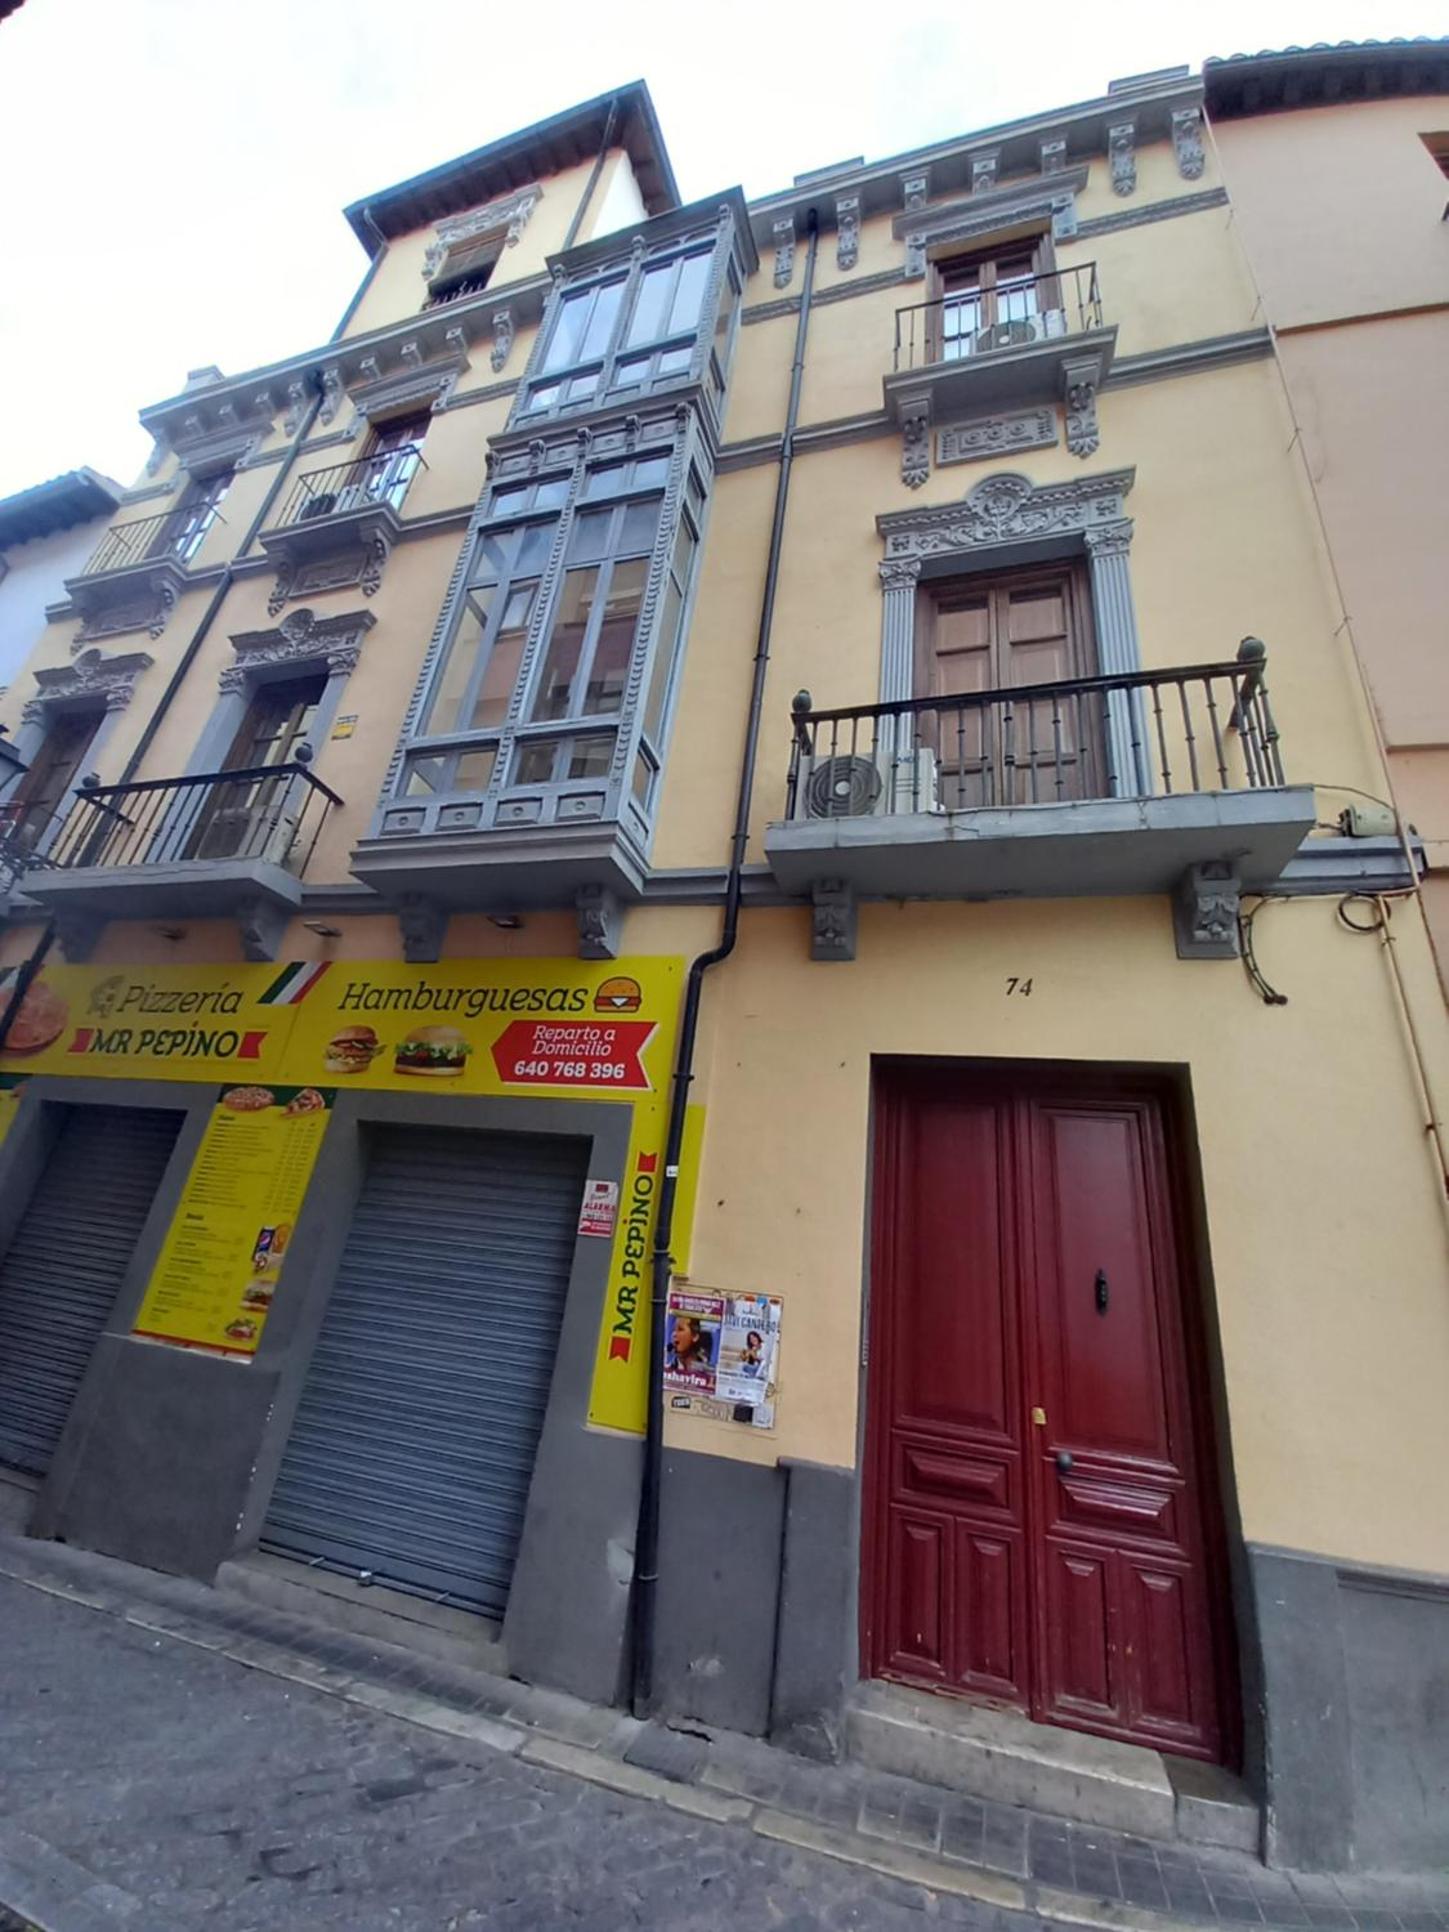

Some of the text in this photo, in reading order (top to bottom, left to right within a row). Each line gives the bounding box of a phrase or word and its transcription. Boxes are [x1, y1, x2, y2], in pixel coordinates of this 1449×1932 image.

[116, 982, 245, 1014] Pizzería
[338, 981, 589, 1018] Hamburguesas
[1006, 977, 1033, 997] 74
[90, 1020, 240, 1058] MR PEPINO
[532, 1024, 616, 1042] Reparto a
[531, 1040, 612, 1057] Domicilio
[514, 1060, 626, 1079] 640 768 396
[613, 1174, 654, 1334] MR PEPINO
